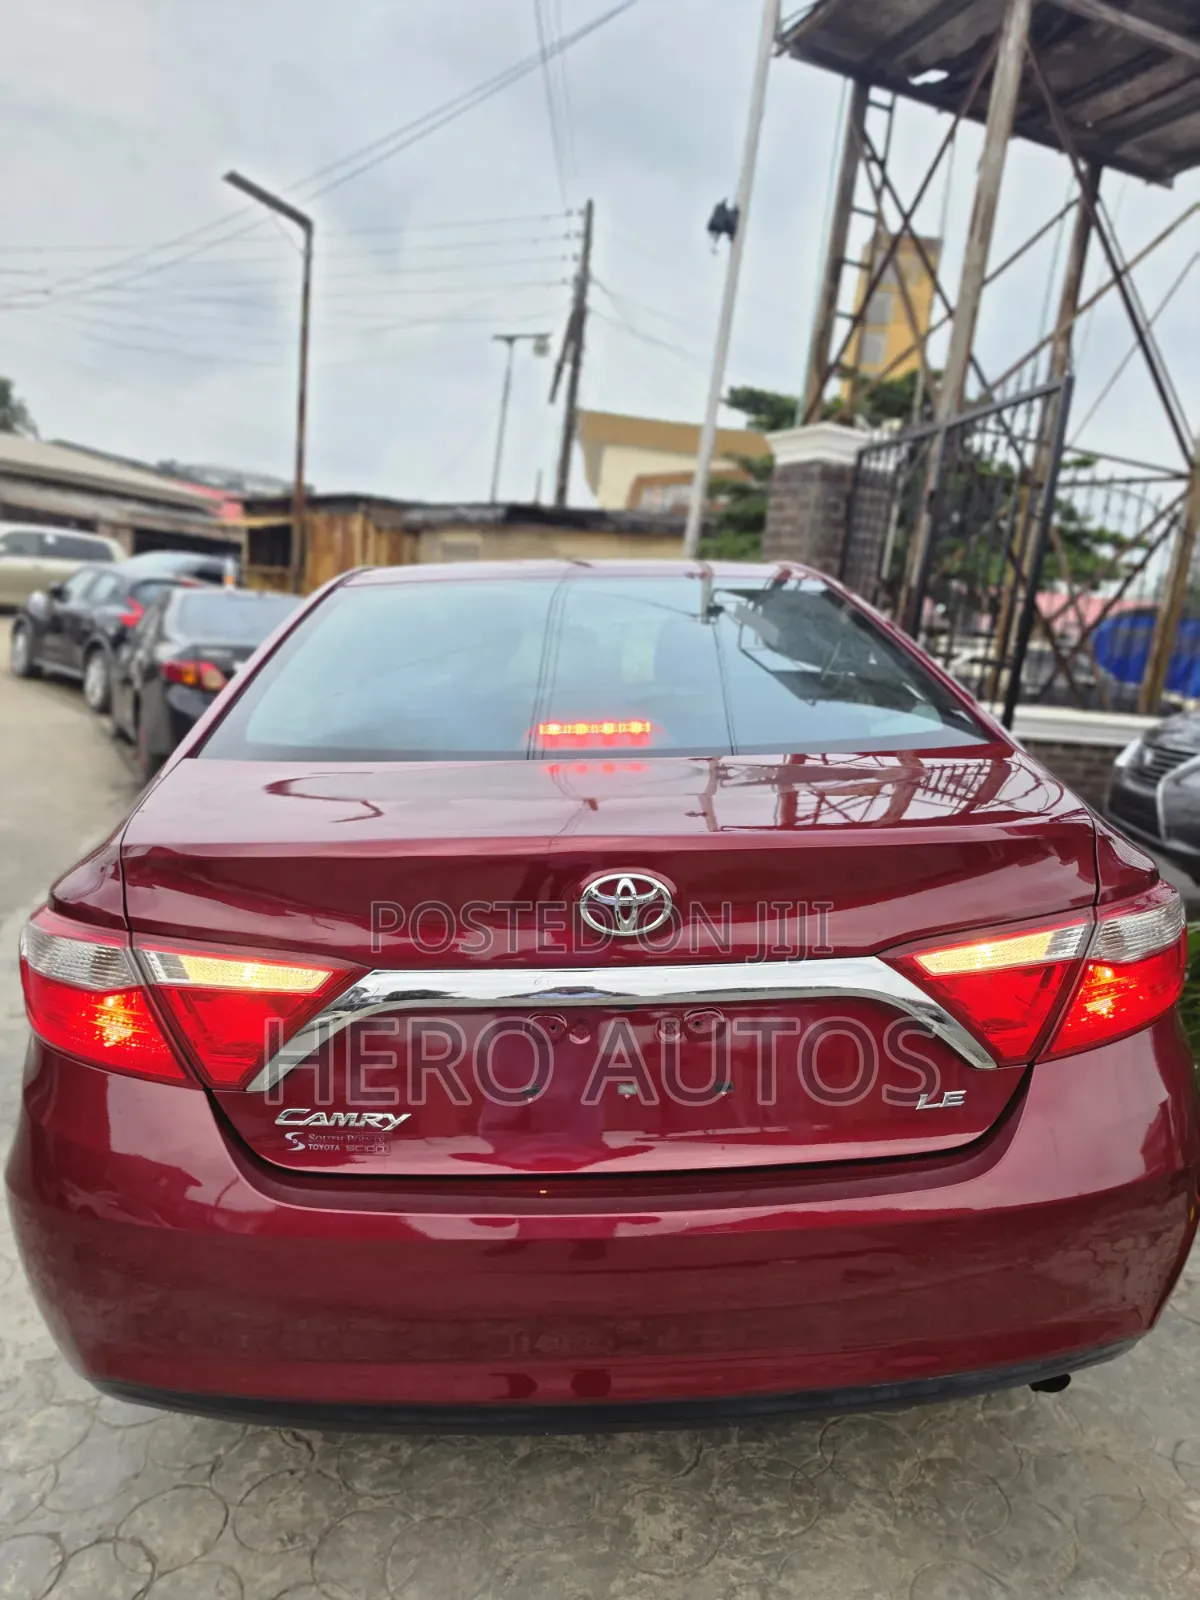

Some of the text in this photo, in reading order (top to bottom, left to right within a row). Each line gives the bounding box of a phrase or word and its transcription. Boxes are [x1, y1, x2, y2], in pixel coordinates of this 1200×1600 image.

[916, 1090, 967, 1110] LE
[274, 1108, 412, 1131] CAMRY
[308, 1143, 340, 1151] TOYOTA
